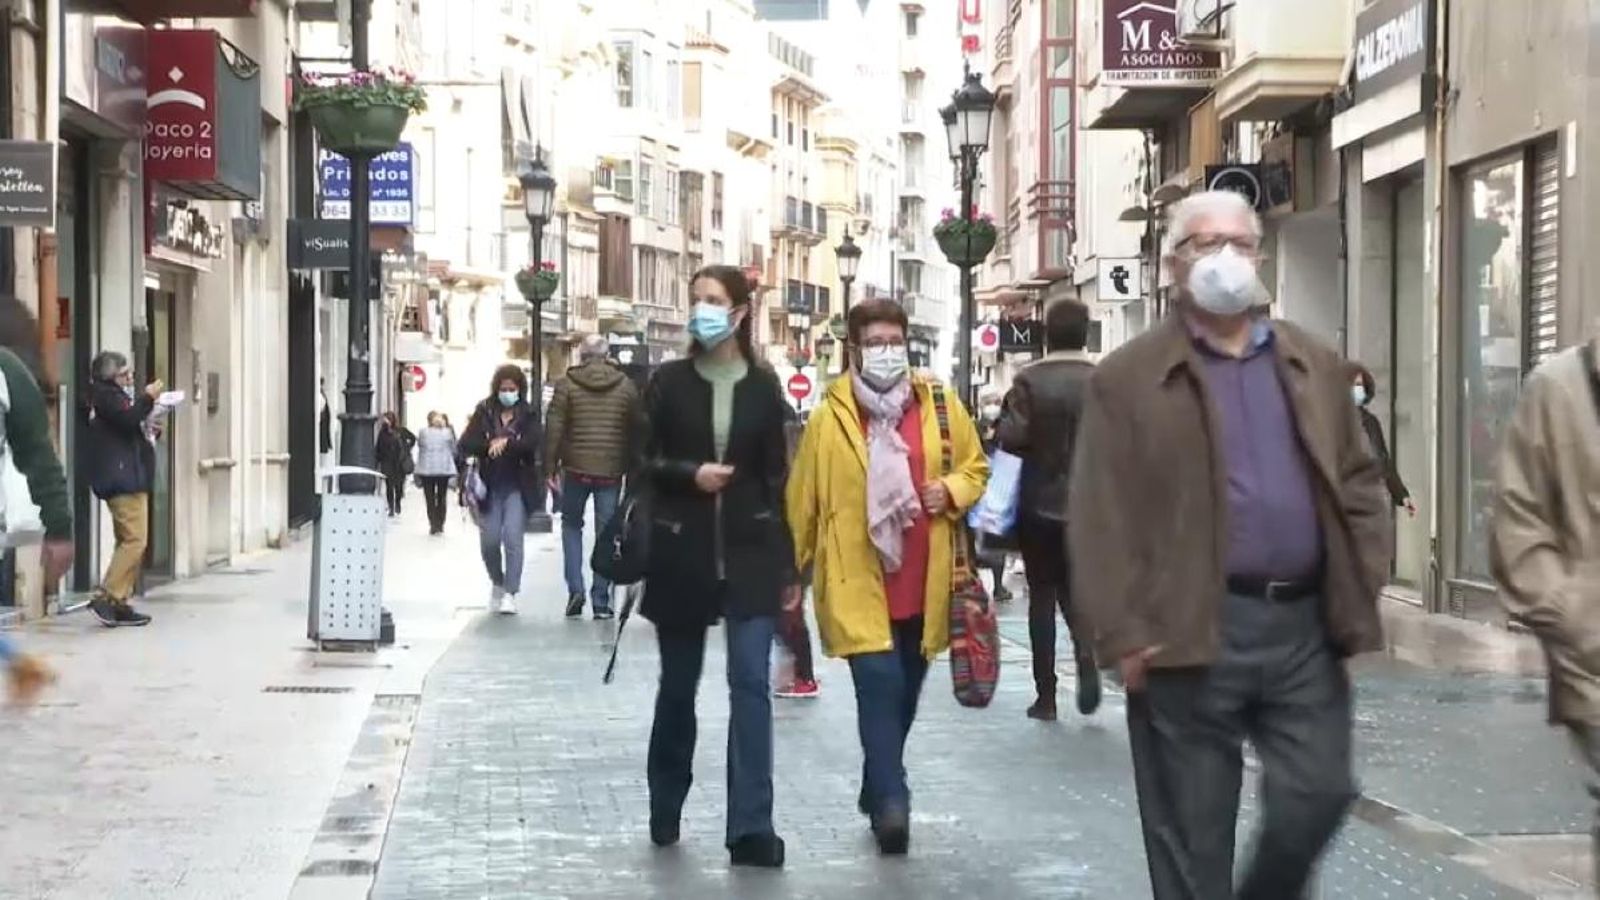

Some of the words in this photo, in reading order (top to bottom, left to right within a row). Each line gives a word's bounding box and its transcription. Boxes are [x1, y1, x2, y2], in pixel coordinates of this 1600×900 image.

[1121, 20, 1152, 51] M
[1120, 52, 1204, 66] ASOCIADOS
[200, 121, 212, 138] 2
